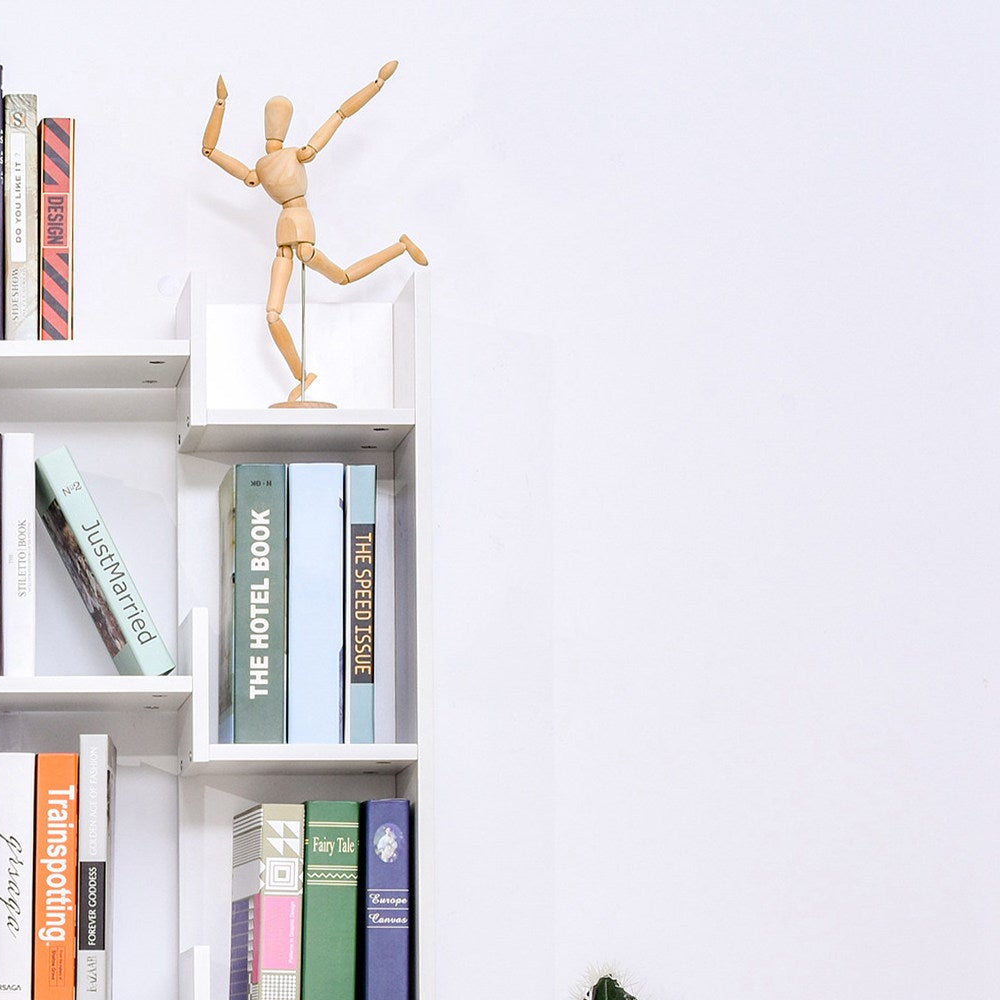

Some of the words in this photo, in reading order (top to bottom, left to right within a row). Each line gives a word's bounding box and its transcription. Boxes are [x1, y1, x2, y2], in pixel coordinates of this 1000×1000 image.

[16, 162, 22, 173] IT
[16, 230, 22, 243] DO
[47, 196, 63, 245] DESIGN
[12, 267, 20, 321] SIDESHOW
[17, 520, 27, 548] BOOK
[251, 509, 271, 571] BOOK
[355, 532, 372, 565] THE
[17, 552, 27, 597] STILETTO
[82, 519, 157, 646] JustMarried
[355, 569, 372, 620] SPEED
[250, 578, 269, 650] HOTEL
[355, 625, 371, 675] ISSUE
[250, 656, 268, 699] THE
[38, 785, 75, 947] Trainspotting.
[313, 837, 335, 856] Fairy
[336, 837, 355, 853] Tale
[88, 867, 96, 907] GODDESS
[369, 893, 408, 907] Europe
[88, 909, 96, 945] FOREVER
[369, 913, 408, 924] Canvas
